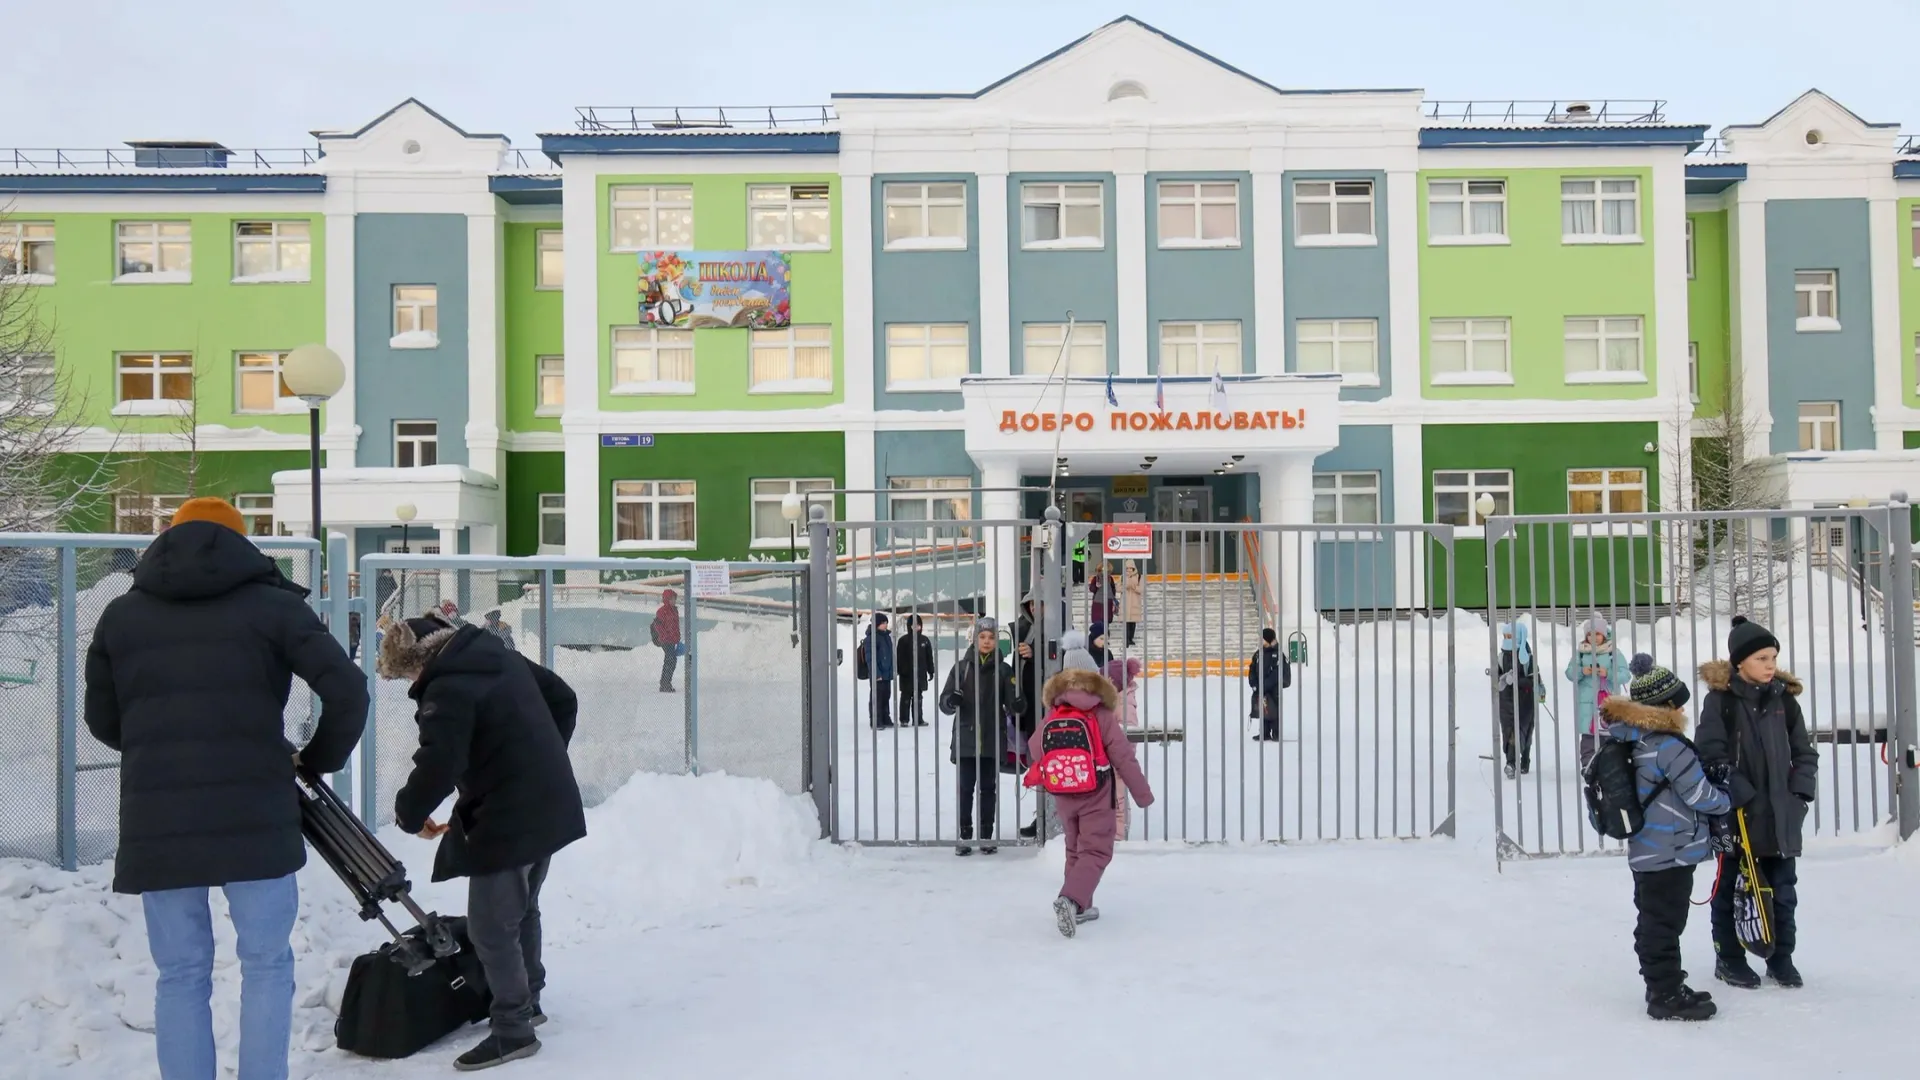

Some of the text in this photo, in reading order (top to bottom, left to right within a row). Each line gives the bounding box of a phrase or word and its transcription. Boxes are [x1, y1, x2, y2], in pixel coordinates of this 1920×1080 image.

[699, 261, 774, 285] ШКОЛА,
[1000, 408, 1306, 432] ДОБРО ПОЖАЛОВАТЬ!
[642, 436, 652, 445] 19
